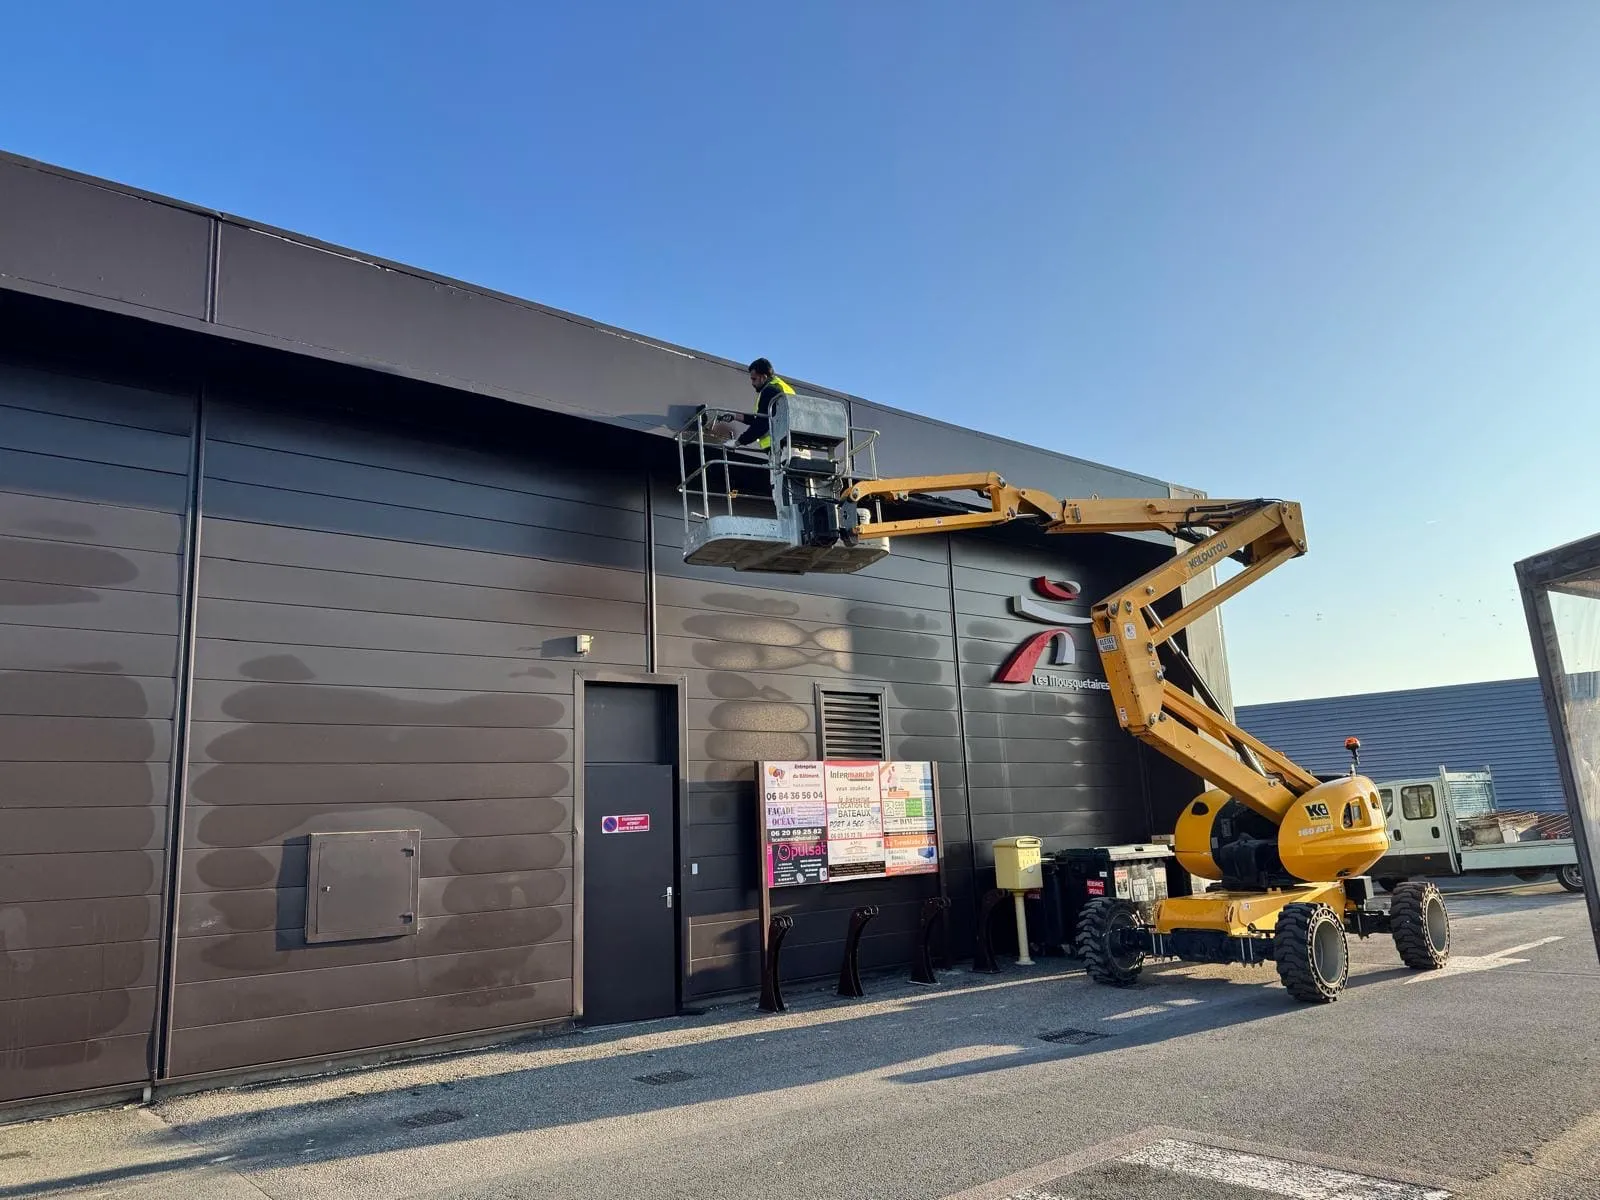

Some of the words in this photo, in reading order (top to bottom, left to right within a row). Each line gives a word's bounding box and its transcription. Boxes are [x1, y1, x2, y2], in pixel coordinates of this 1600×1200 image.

[766, 792, 777, 801] 06
[778, 792, 789, 800] 84
[812, 791, 823, 799] 04
[838, 809, 871, 817] BATEAUX
[772, 817, 796, 825] OCÉAN
